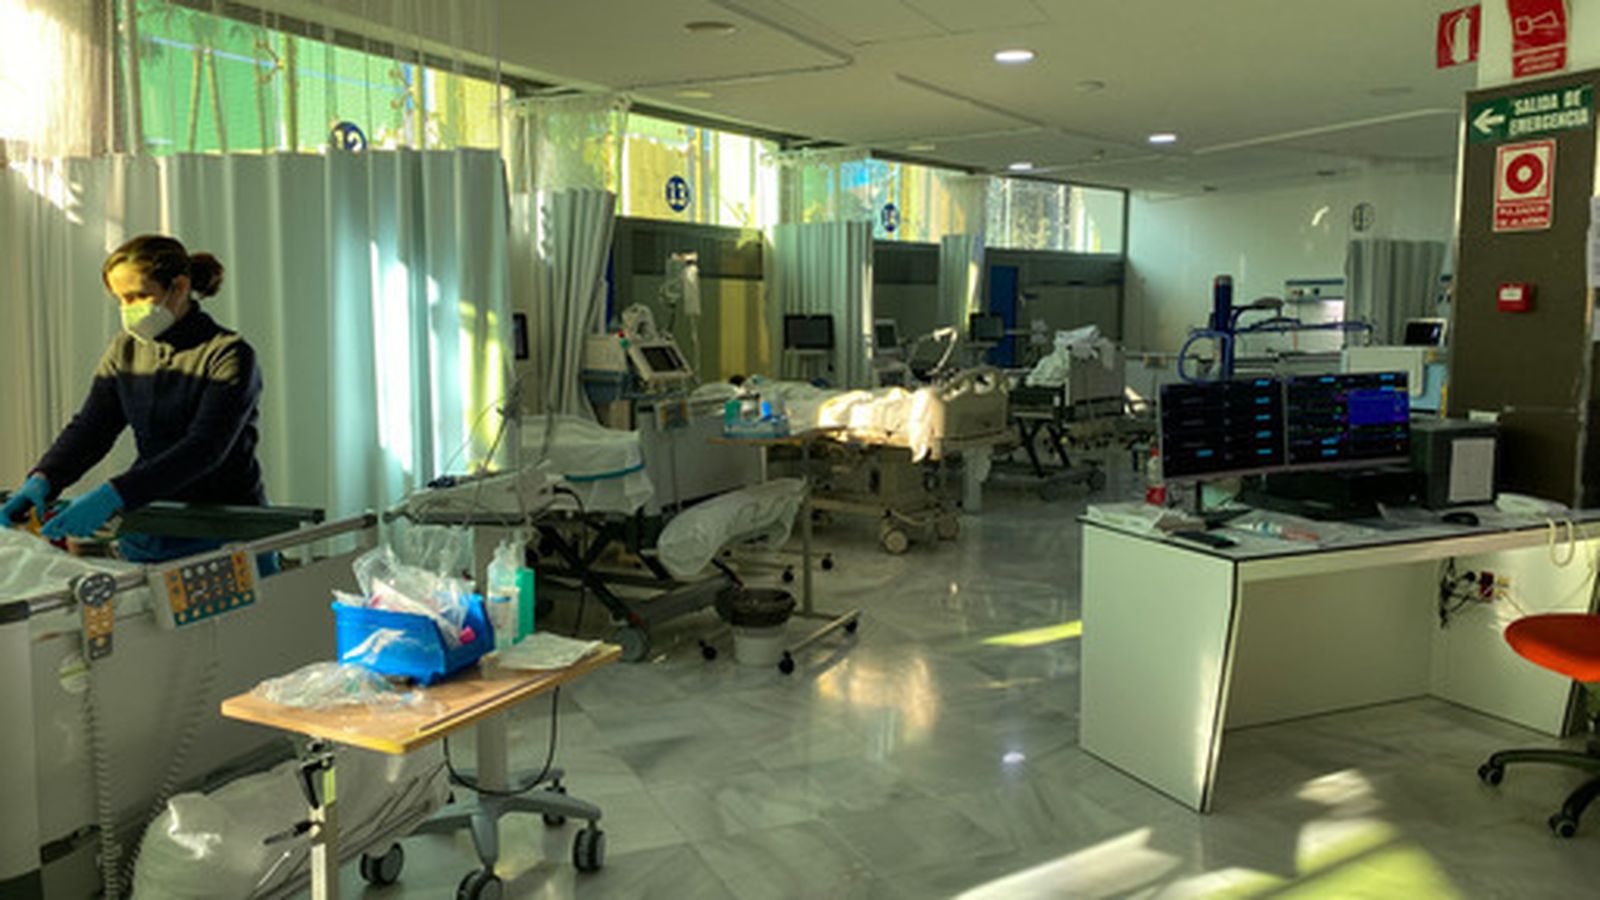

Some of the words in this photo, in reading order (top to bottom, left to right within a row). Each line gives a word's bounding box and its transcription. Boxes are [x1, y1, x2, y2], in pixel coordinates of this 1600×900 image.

[1514, 94, 1558, 116] SALIDA
[1563, 89, 1581, 108] DE
[1509, 107, 1588, 136] EMERGENCIA
[669, 182, 687, 205] 13
